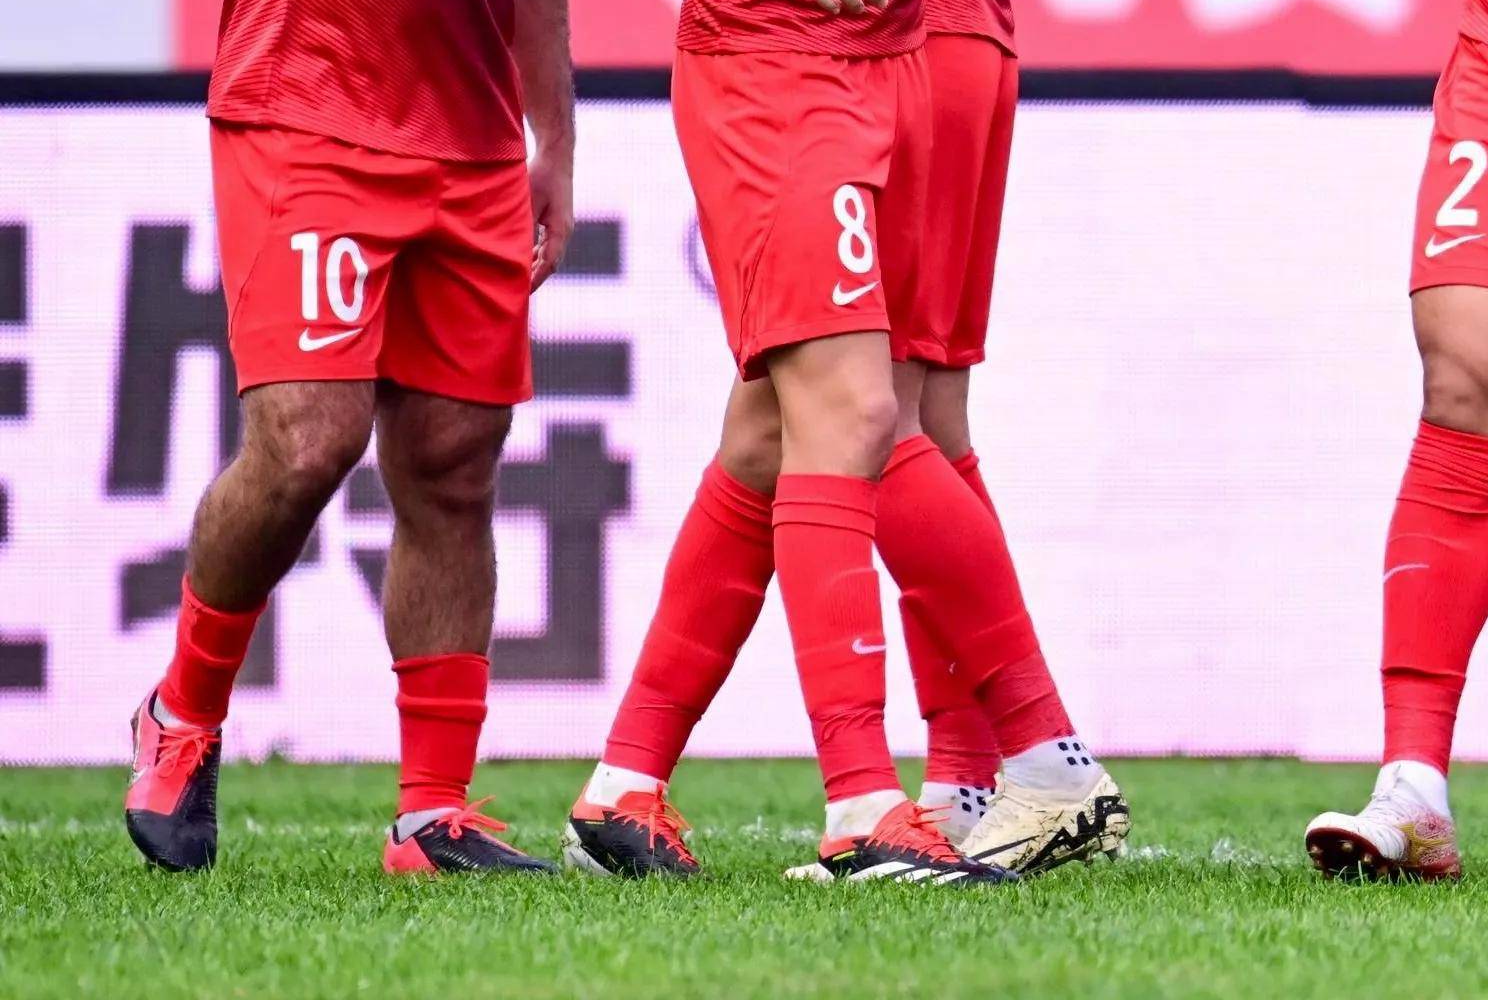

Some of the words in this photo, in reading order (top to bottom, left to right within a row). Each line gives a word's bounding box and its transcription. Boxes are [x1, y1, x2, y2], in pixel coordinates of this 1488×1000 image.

[1435, 139, 1488, 227] 2
[832, 184, 874, 274] 8
[290, 231, 369, 322] 10
